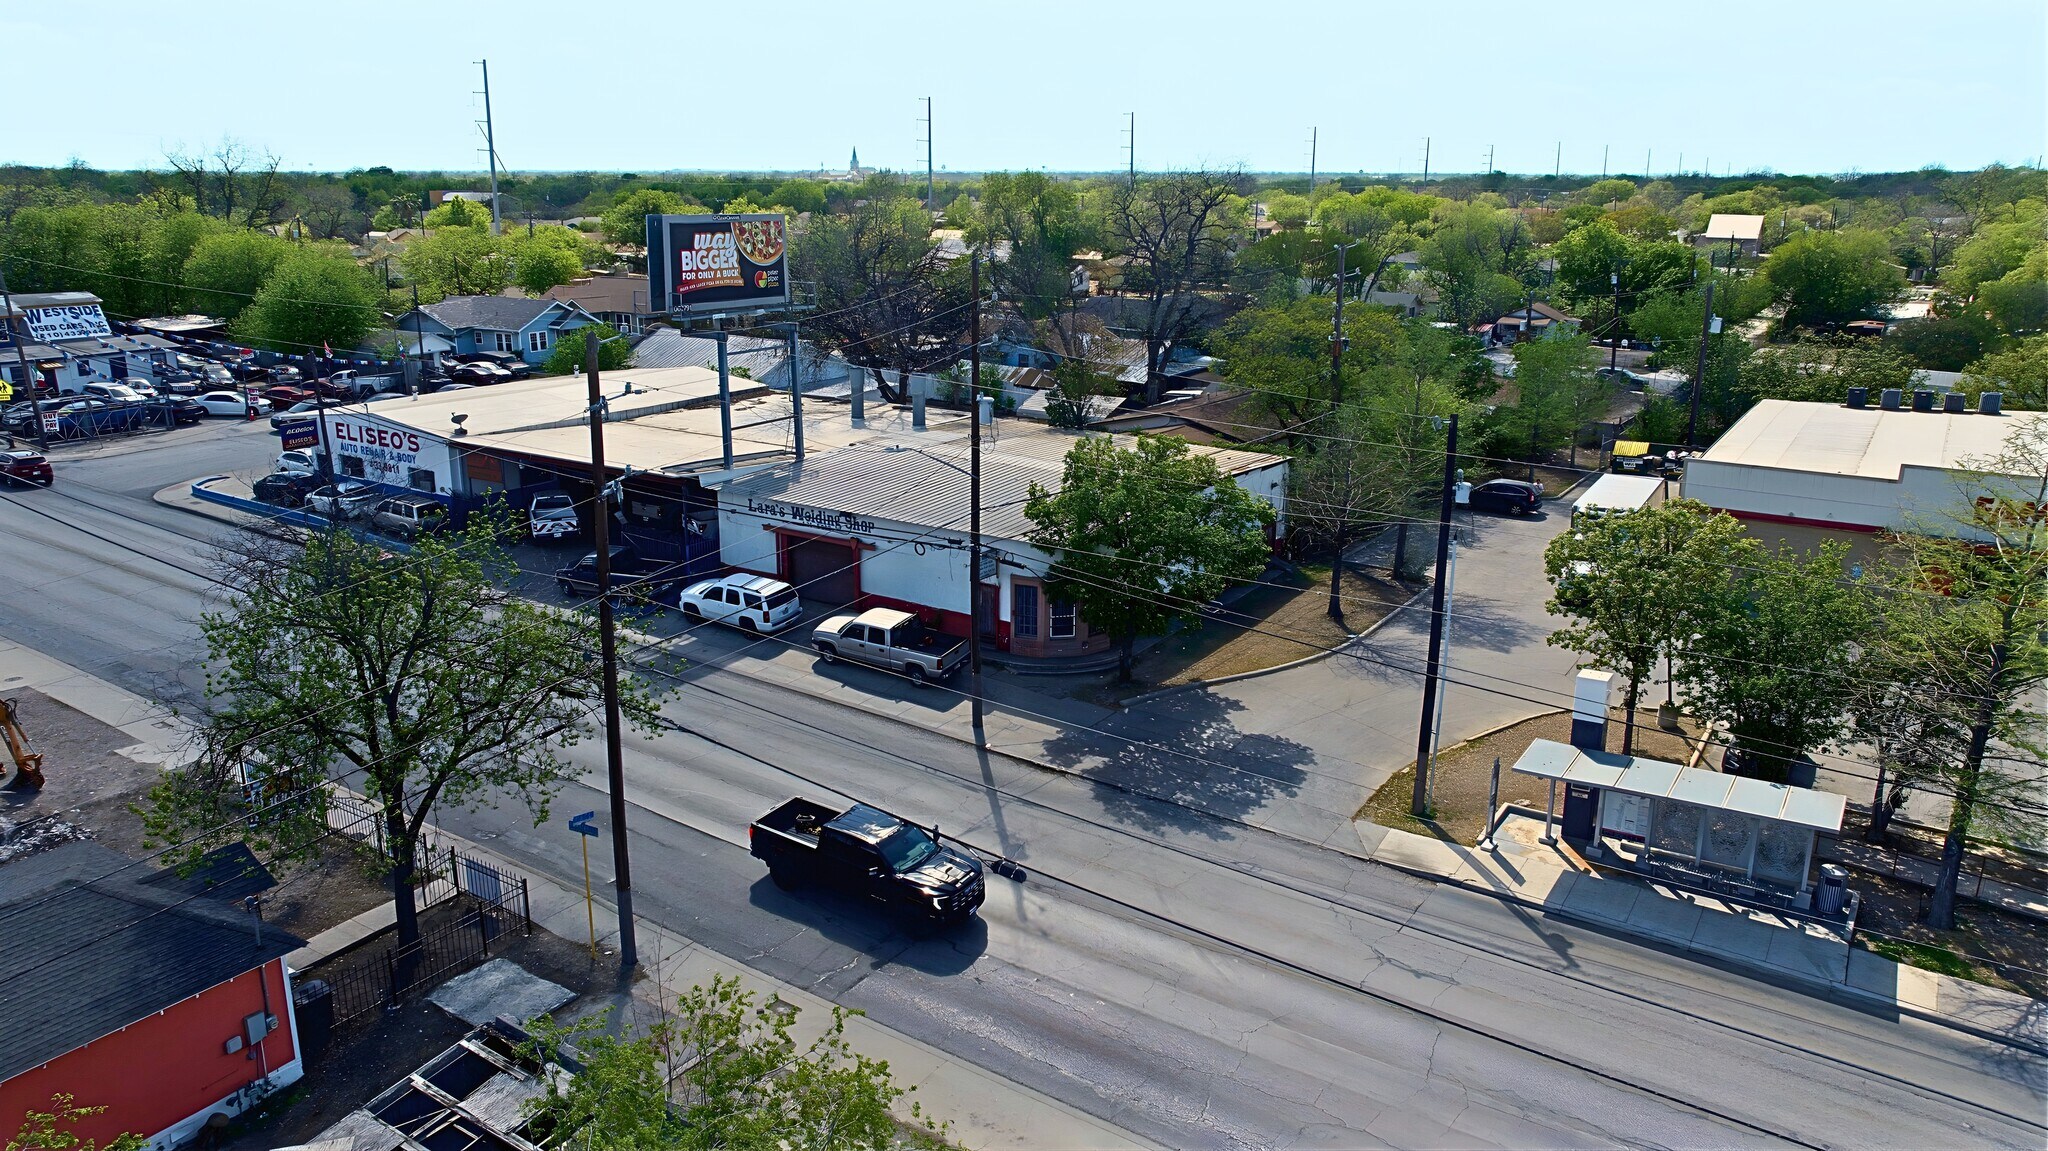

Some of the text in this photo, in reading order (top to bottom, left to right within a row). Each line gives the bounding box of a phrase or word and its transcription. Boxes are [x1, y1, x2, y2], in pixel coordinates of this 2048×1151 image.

[681, 249, 739, 271] BIGGER
[682, 269, 740, 281] FOR ONLY A BUCK
[23, 305, 102, 324] WESTSIDE
[30, 324, 57, 332] USED
[335, 421, 420, 452] ELISEO'S
[340, 442, 358, 454] AUTO
[397, 452, 416, 464] BODY
[748, 498, 786, 517] Lara's
[790, 505, 842, 528] Welding
